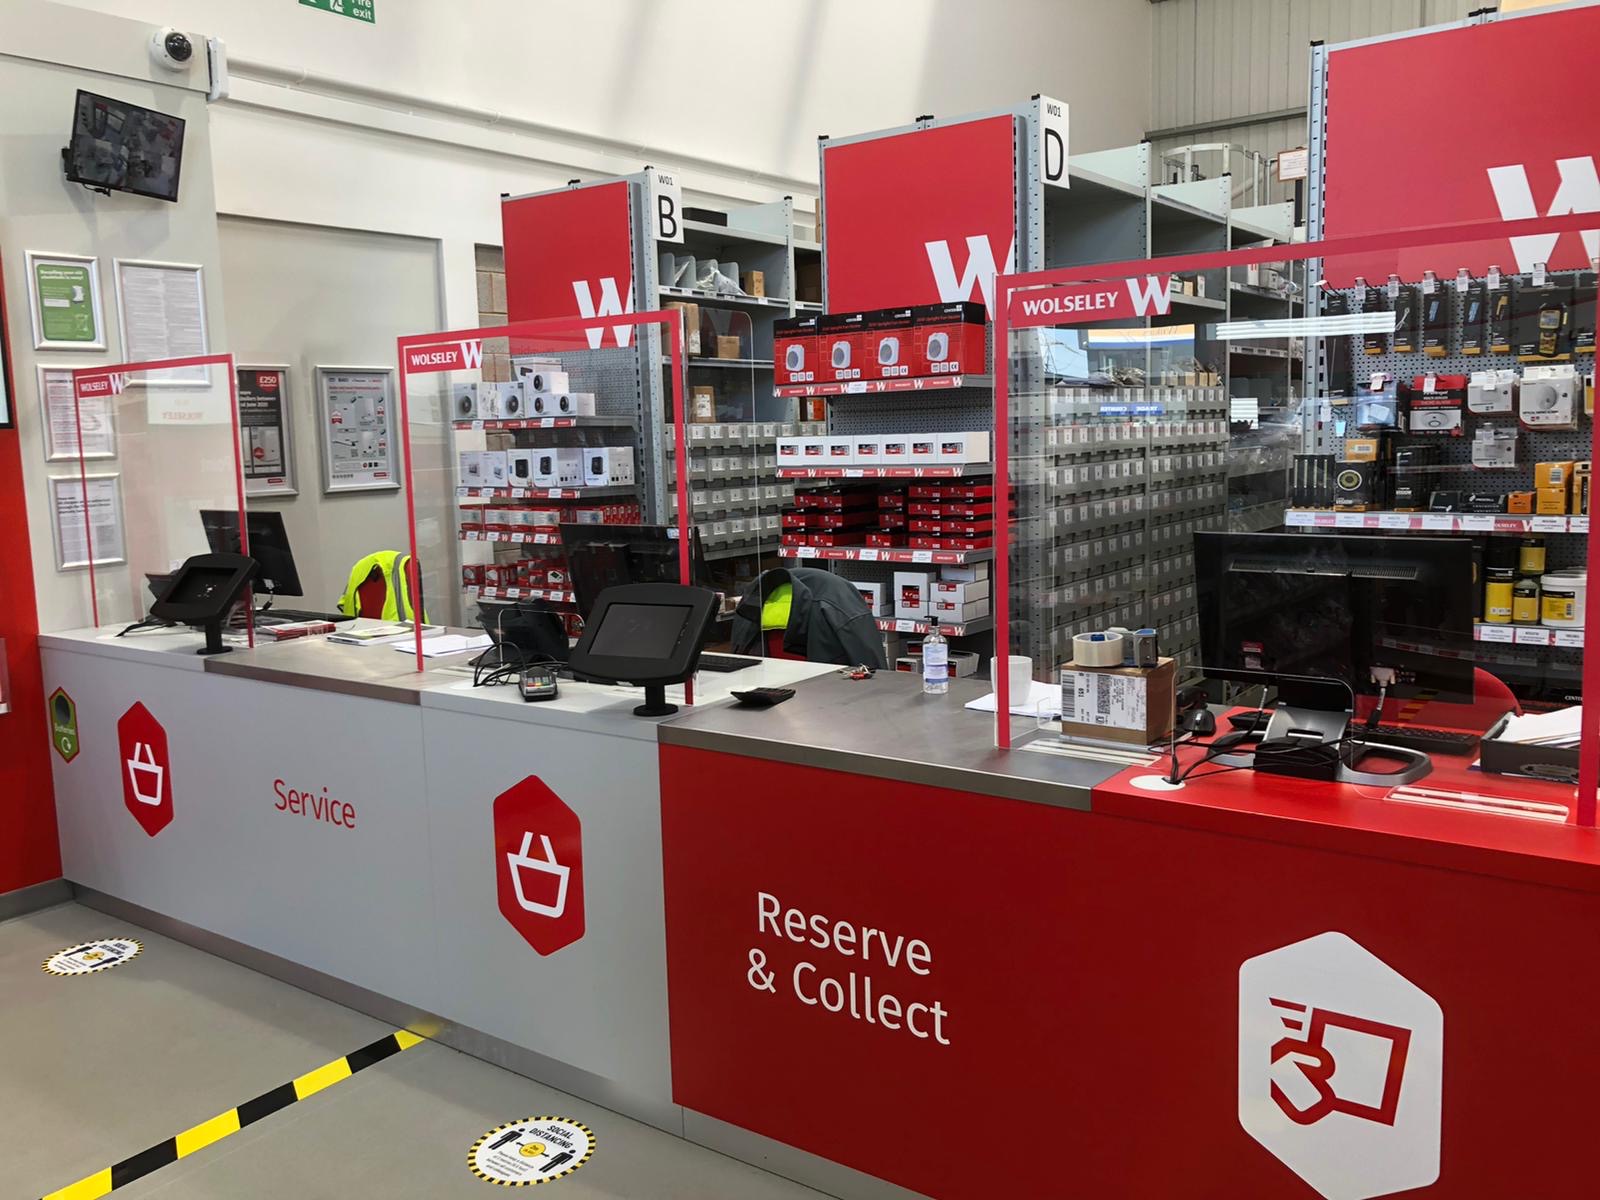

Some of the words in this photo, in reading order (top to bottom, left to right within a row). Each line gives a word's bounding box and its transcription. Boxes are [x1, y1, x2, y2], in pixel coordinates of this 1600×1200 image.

[352, 8, 373, 20] exit
[1046, 102, 1062, 118] W01
[1044, 127, 1065, 182] D
[657, 173, 674, 187] W01
[657, 194, 678, 239] B
[1022, 291, 1119, 317] WOLSELEY
[1125, 275, 1171, 317] W
[572, 277, 635, 350] W
[410, 351, 458, 366] WOLSELEY
[460, 341, 483, 369] W
[80, 381, 109, 392] WOLSELEY
[109, 373, 124, 395] W
[259, 376, 277, 384] £250
[807, 386, 815, 395] W
[877, 381, 887, 391] W
[914, 379, 924, 389] W
[807, 468, 816, 477] W
[877, 468, 887, 477] W
[914, 468, 925, 477] W
[952, 467, 964, 477] W
[846, 550, 855, 559] W
[881, 551, 891, 561] W
[879, 620, 890, 630] W
[273, 778, 356, 830] Service
[757, 890, 932, 976] Reserve
[746, 947, 776, 994] &
[792, 960, 951, 1046] Collect
[528, 1127, 574, 1150] DISTANCING
[547, 1125, 574, 1140] SOCIAL
